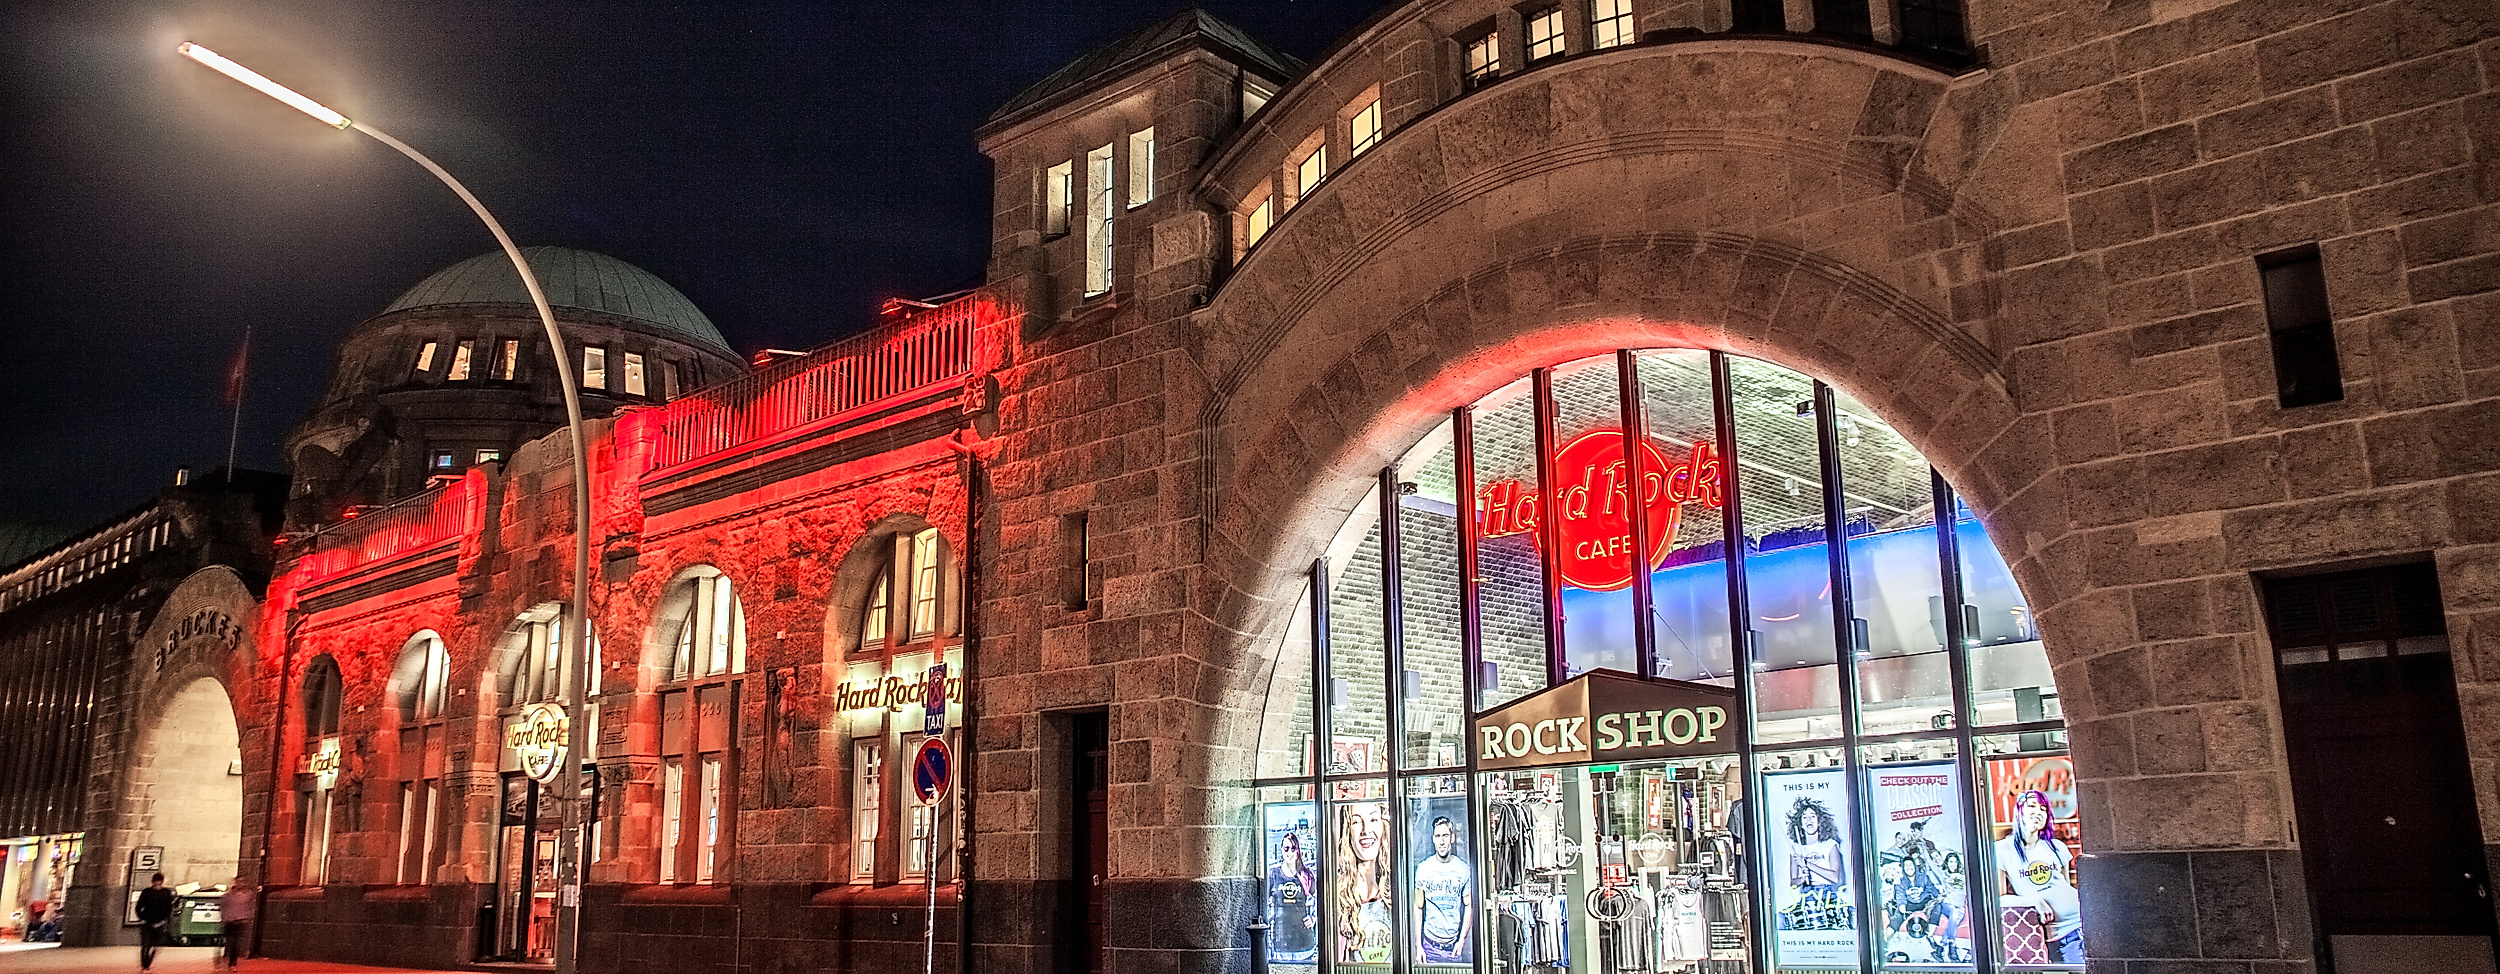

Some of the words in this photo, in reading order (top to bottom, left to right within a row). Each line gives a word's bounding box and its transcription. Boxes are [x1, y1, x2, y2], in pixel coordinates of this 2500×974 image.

[1479, 463, 1596, 537] Had
[1576, 534, 1632, 561] CAFE
[836, 677, 883, 712] Hard
[883, 671, 927, 712] Rock
[926, 713, 944, 730] TAXI
[1480, 716, 1588, 760] ROCK
[1596, 705, 1727, 751] SHOP
[1881, 777, 1910, 785] CHECK
[1911, 777, 1929, 785] OUT
[1888, 783, 1943, 809] CLASSIC
[1892, 806, 1943, 820] COLLECTION
[1628, 839, 1652, 851] Hard
[1652, 837, 1675, 853] Rock
[141, 854, 156, 867] 5
[2019, 865, 2038, 878] Hard
[2039, 861, 2059, 875] Rock
[1780, 885, 1853, 914] STYLE
